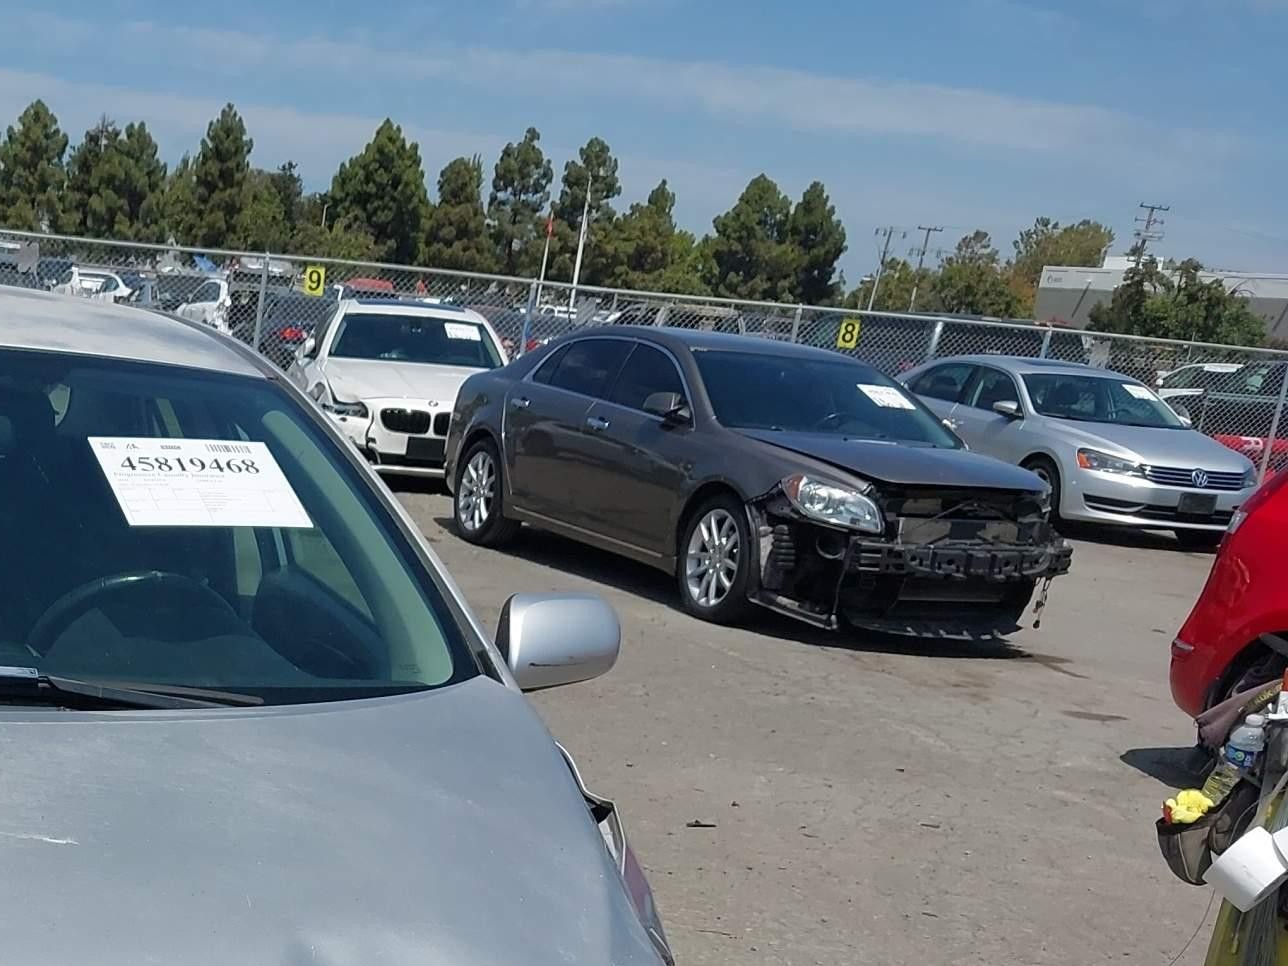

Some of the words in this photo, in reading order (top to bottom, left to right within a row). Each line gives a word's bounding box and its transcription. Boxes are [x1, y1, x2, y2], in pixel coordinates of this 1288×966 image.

[308, 269, 322, 292] 9
[842, 322, 856, 344] 8
[120, 456, 260, 475] 45819468
